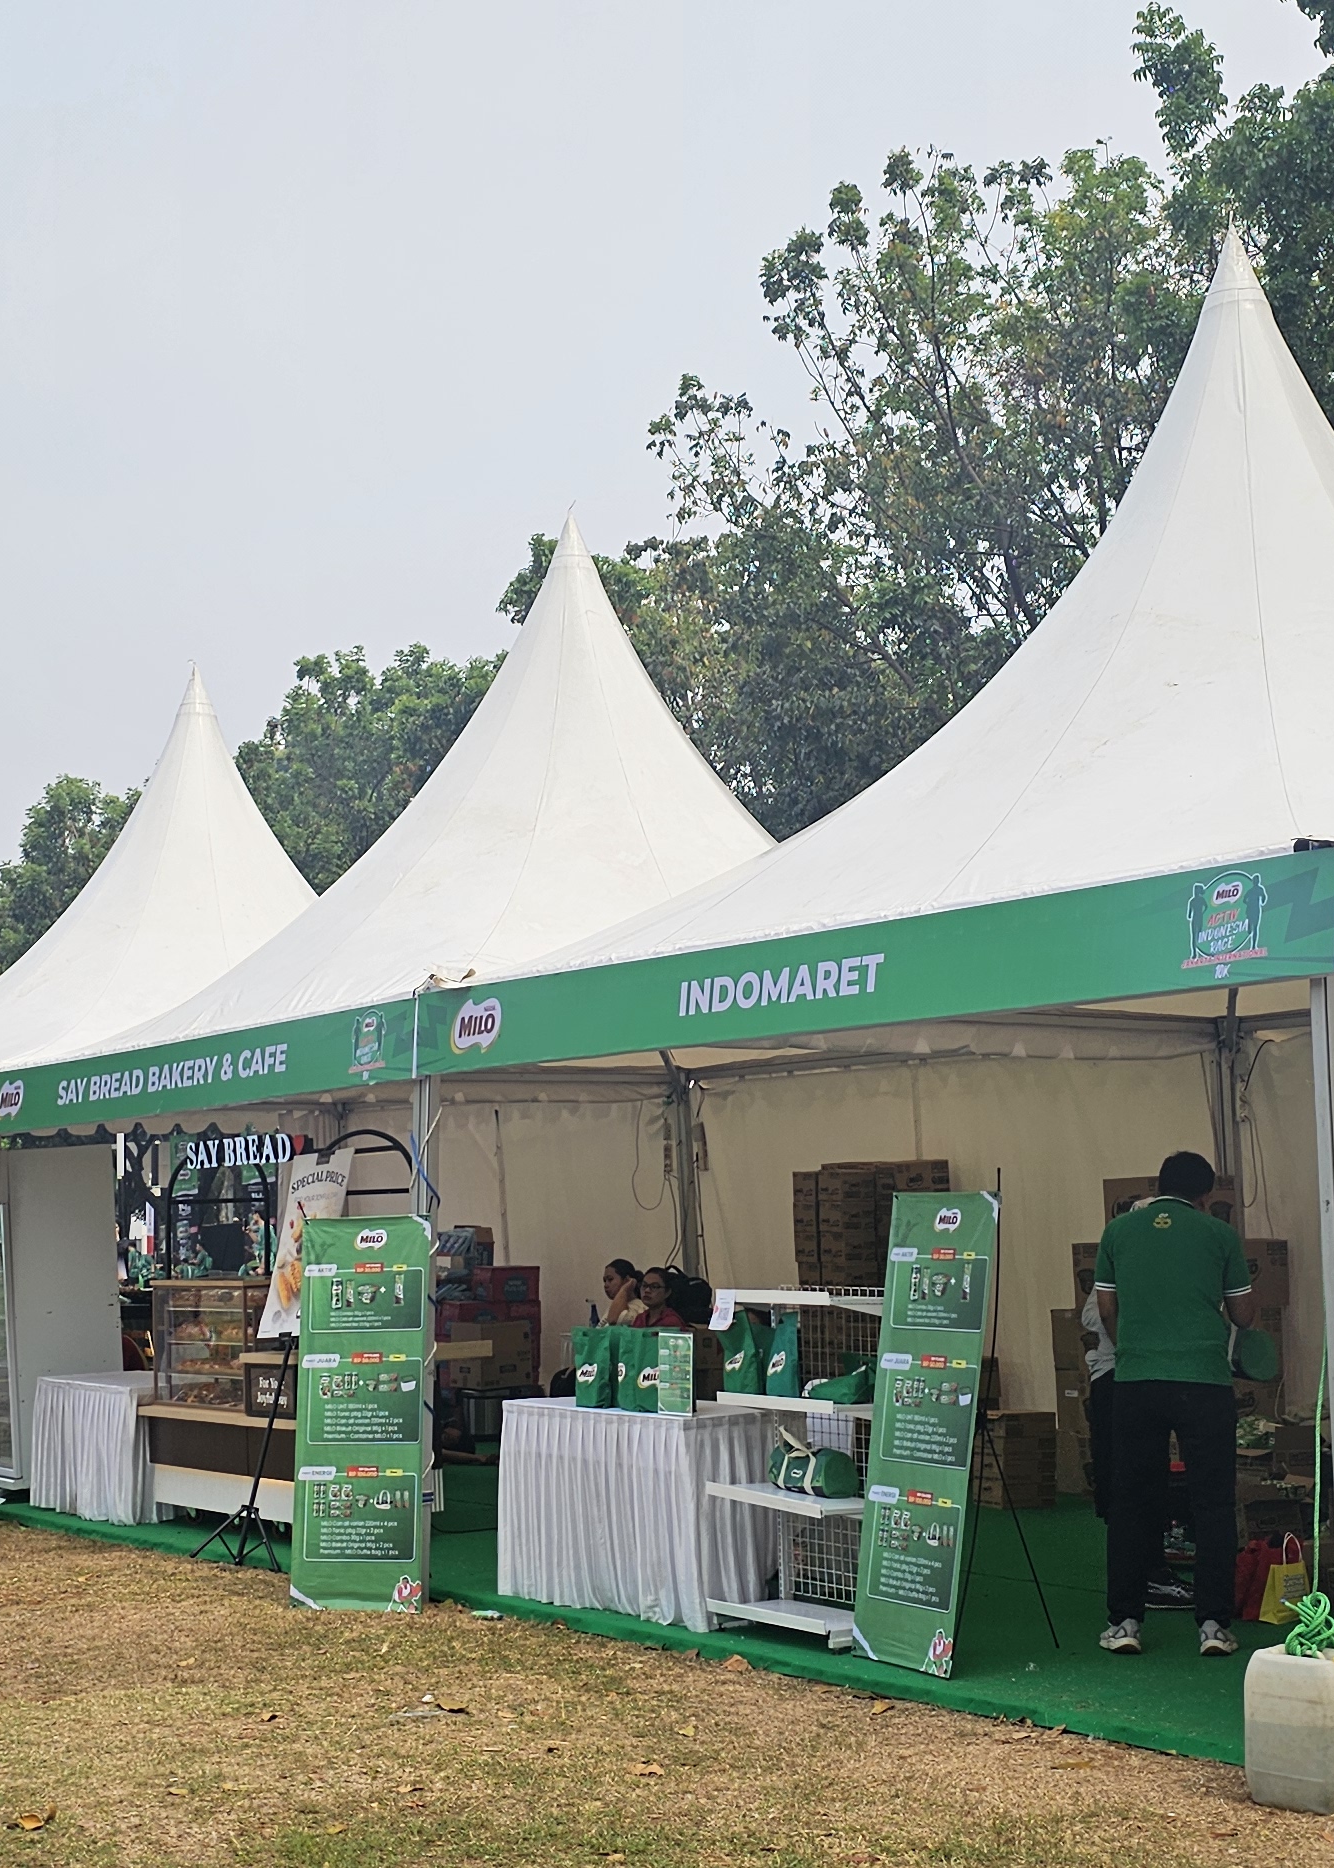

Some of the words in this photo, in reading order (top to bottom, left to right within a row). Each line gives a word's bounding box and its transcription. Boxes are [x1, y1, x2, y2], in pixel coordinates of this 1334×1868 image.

[1216, 887, 1239, 900] MILO
[1198, 919, 1248, 943] INDONESIA
[1210, 937, 1234, 953] RACE
[1215, 964, 1231, 979] 10K
[679, 953, 885, 1016] INDOMARET
[458, 1011, 496, 1039] MILO
[57, 1081, 87, 1106] SAY
[89, 1072, 144, 1101] BREAD
[147, 1056, 218, 1093] BAKERY
[220, 1055, 233, 1081] &
[238, 1044, 288, 1078] CAFE
[0, 1091, 20, 1109] MILO
[186, 1139, 220, 1170] SAY
[223, 1134, 291, 1167] BREAD
[291, 1171, 324, 1195] SPECIAL
[324, 1170, 346, 1188] PRICE
[937, 1215, 958, 1225] MILO
[359, 1235, 384, 1244] MILO
[259, 1376, 269, 1388] For
